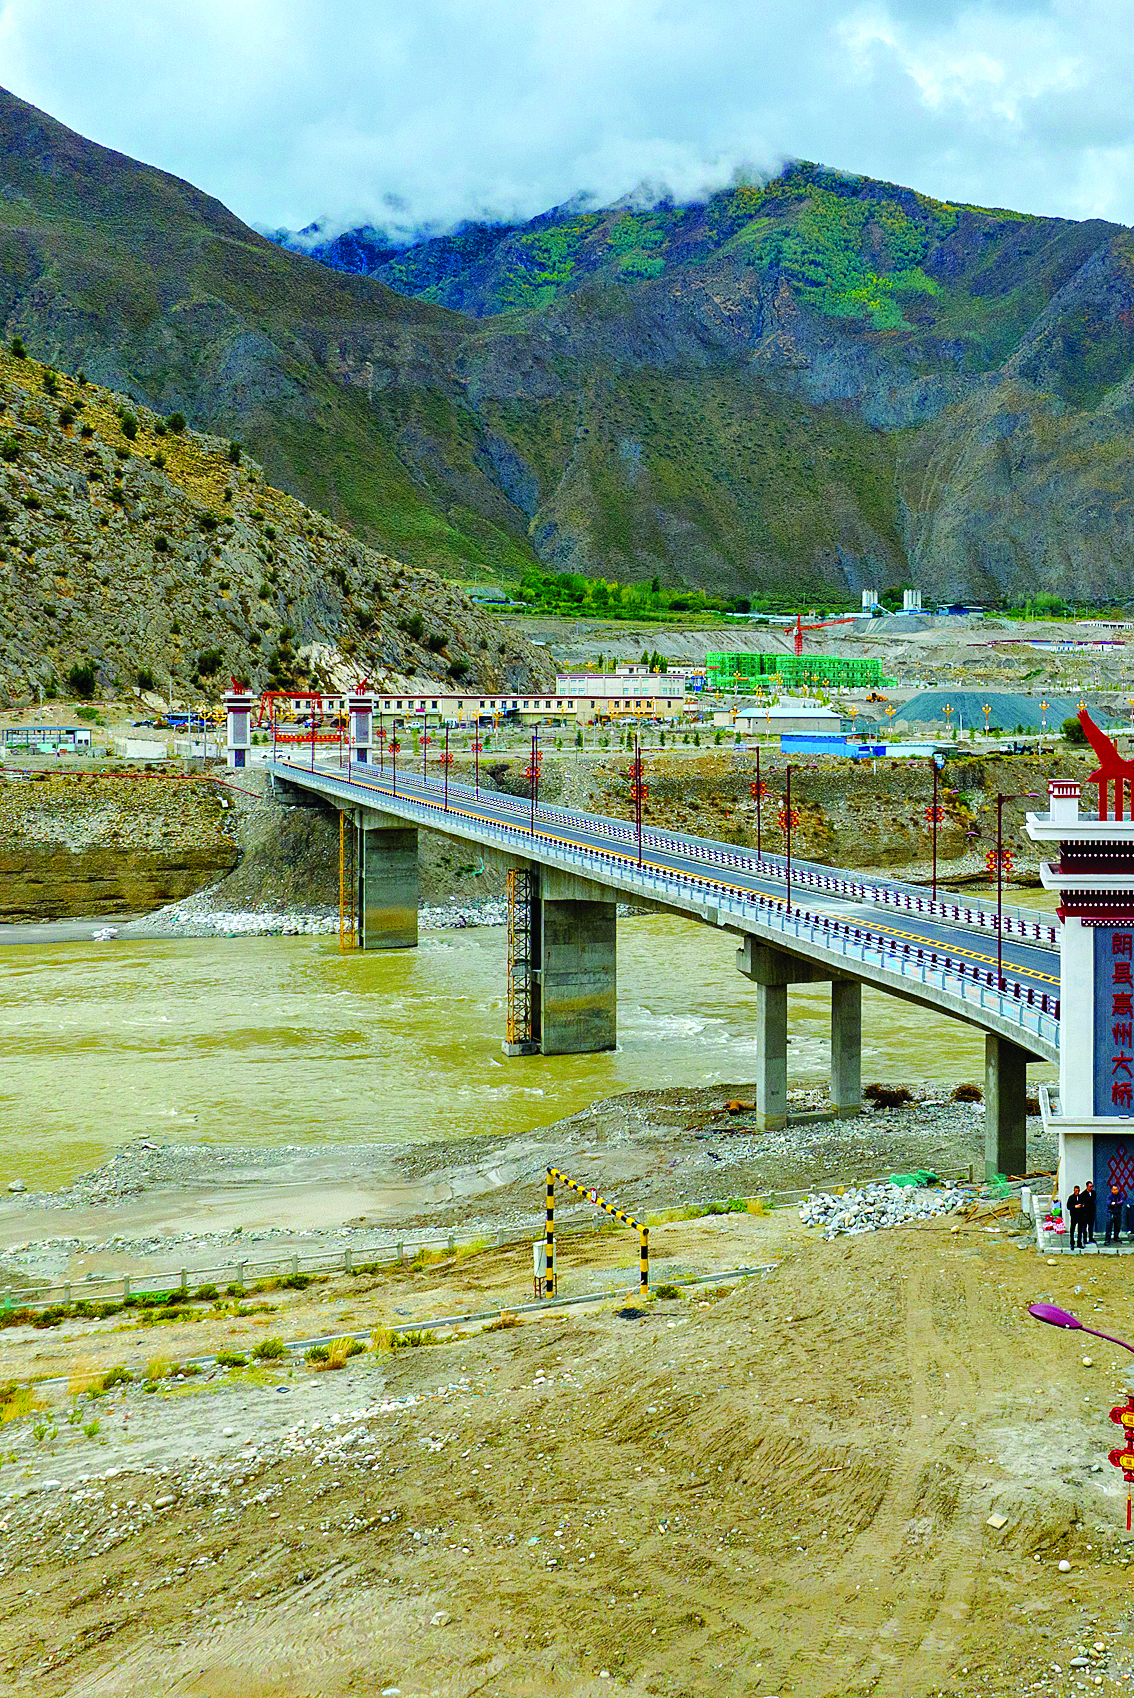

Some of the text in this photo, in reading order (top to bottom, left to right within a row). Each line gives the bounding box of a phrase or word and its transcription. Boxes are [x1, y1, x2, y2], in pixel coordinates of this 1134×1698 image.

[1111, 932, 1134, 1109] 朗县惠州大桥
